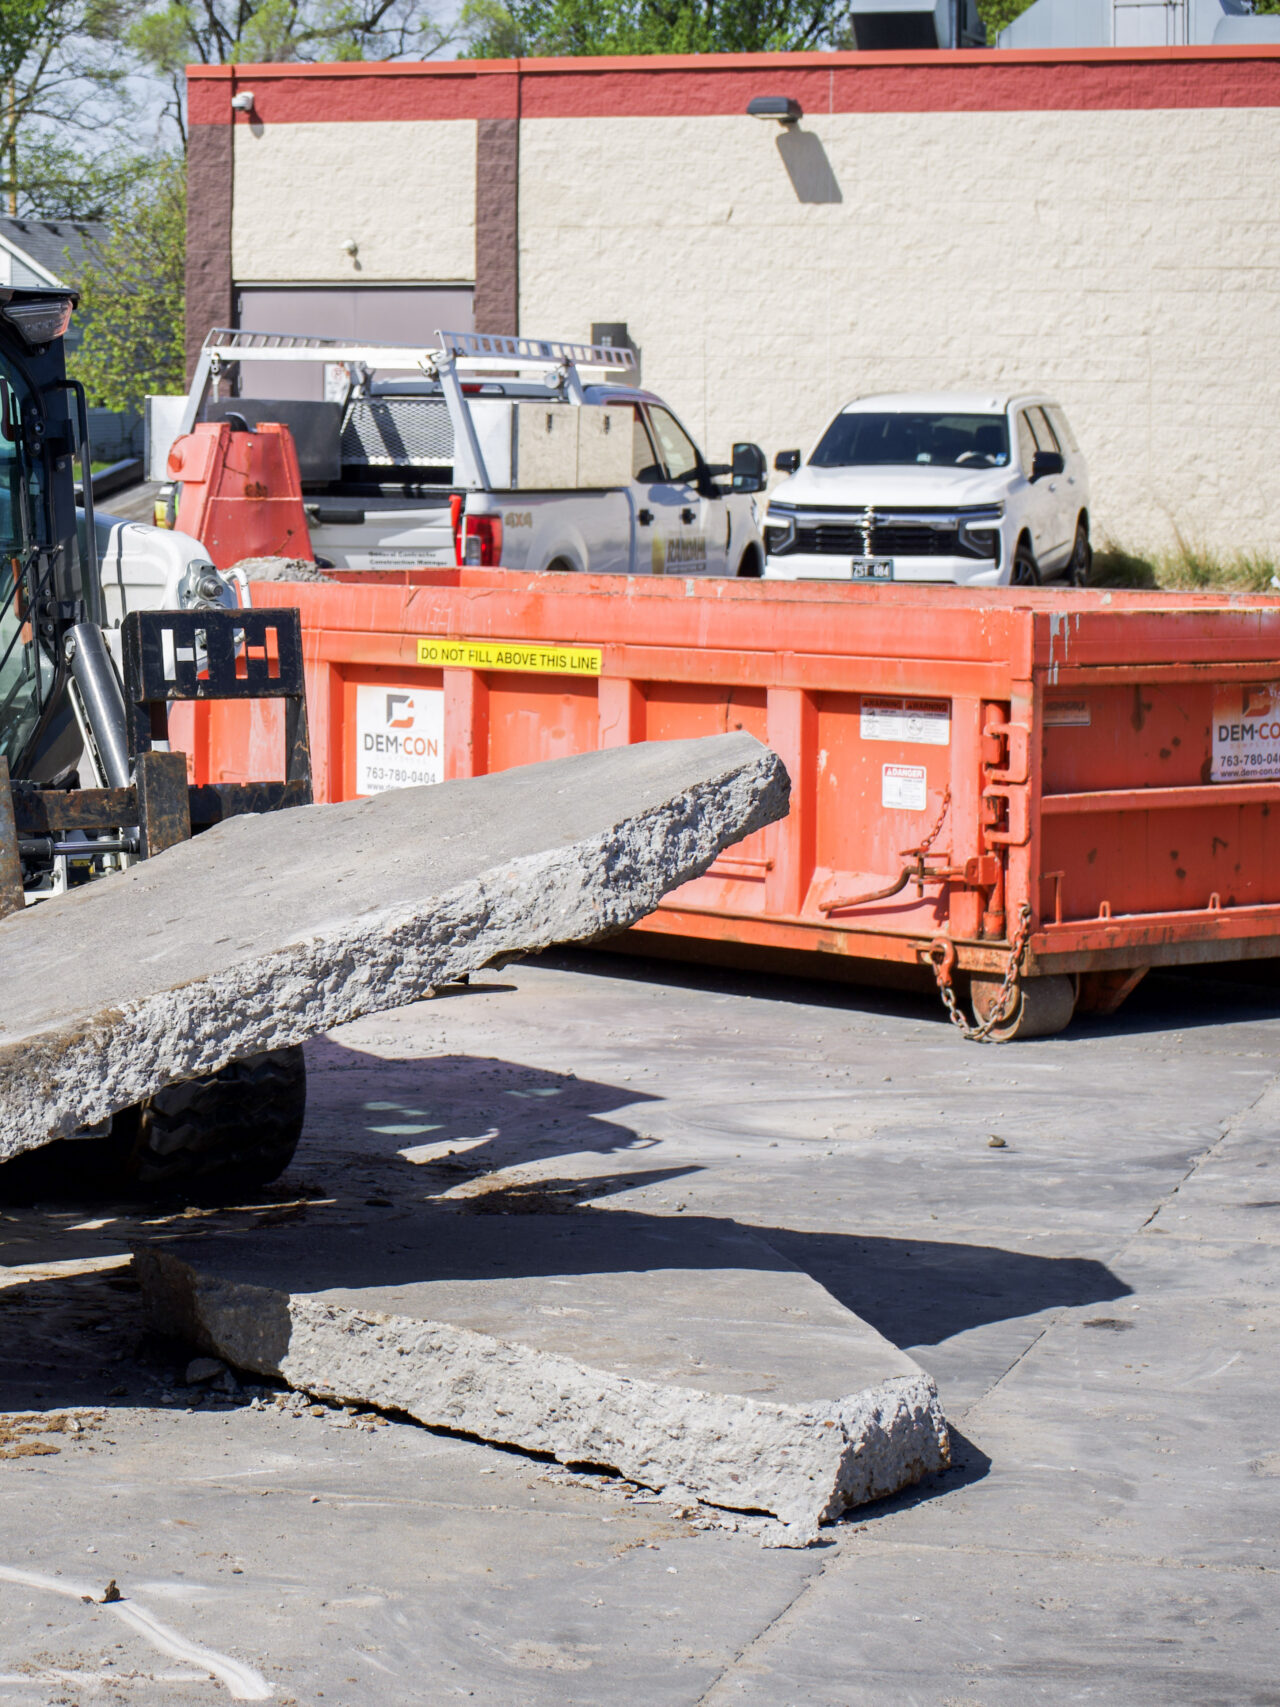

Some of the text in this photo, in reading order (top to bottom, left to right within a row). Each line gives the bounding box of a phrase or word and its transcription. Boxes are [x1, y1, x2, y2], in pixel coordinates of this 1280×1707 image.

[421, 647, 598, 670] DO NOT FILL ABOVE THIS LINE
[366, 766, 436, 784] 763-780-0404
[892, 767, 923, 778] DANGER
